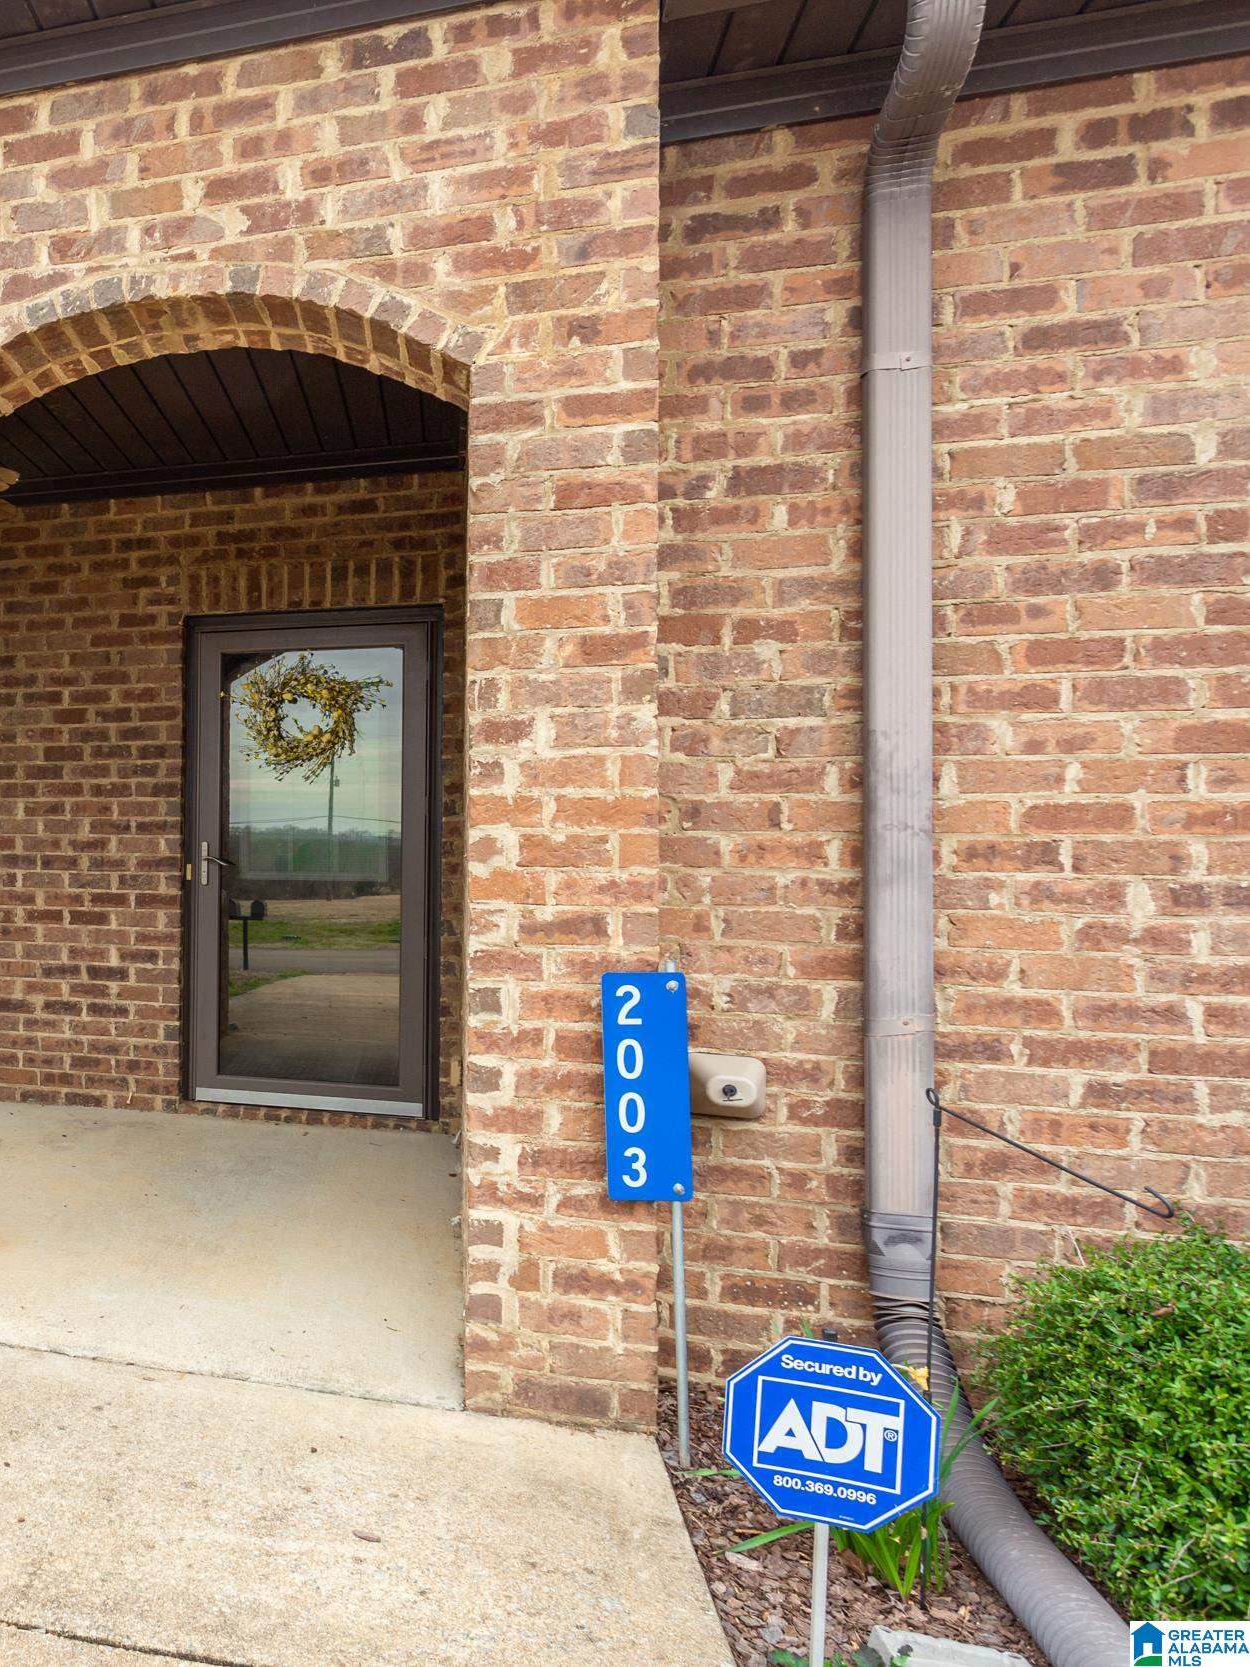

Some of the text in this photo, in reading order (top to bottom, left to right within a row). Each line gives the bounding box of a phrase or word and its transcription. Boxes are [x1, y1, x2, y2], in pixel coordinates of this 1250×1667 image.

[615, 984, 648, 1188] 2003
[781, 1354, 882, 1386] Secured by
[773, 1475, 877, 1505] 800.369.0996
